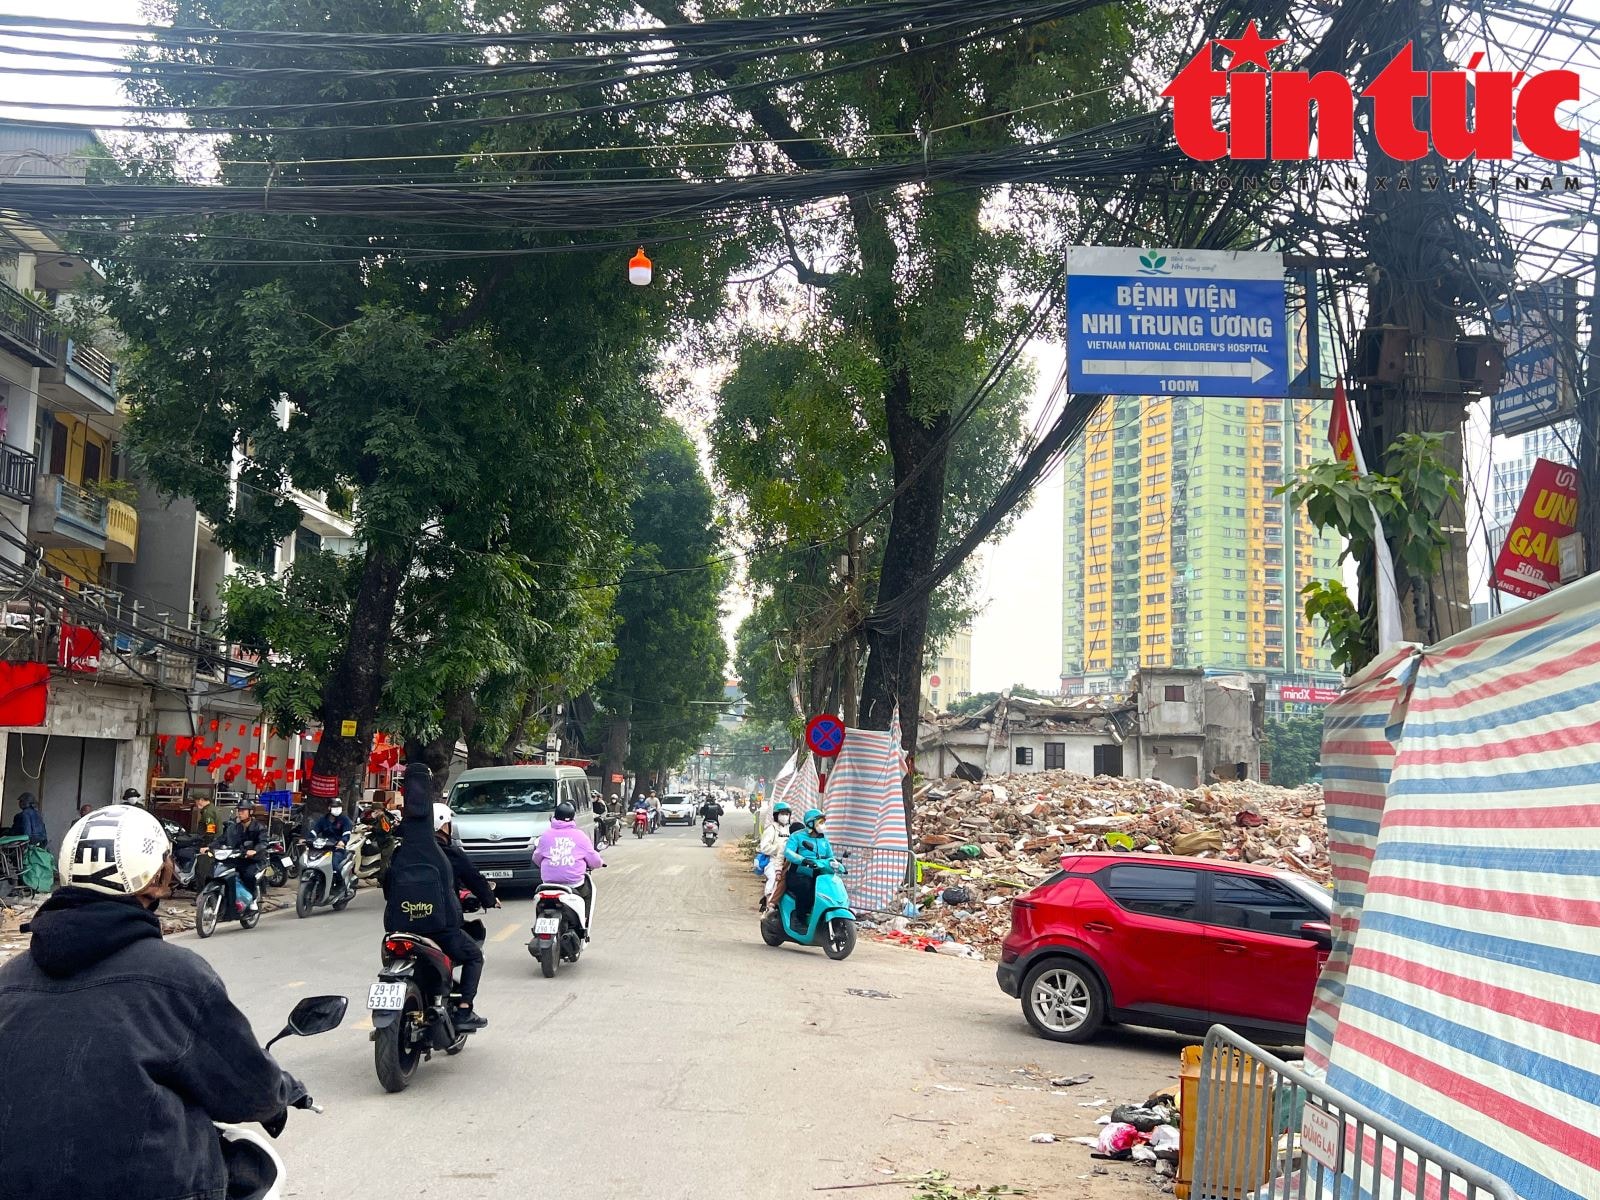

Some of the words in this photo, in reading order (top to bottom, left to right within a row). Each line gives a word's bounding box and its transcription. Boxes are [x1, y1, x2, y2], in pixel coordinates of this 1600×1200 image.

[1117, 282, 1178, 311] BỆNH
[1184, 284, 1236, 313] VIỆN
[1082, 313, 1121, 334] NHI
[1128, 315, 1204, 336] TRUNG
[1210, 314, 1273, 338] ƯƠNG
[1087, 340, 1127, 350] VIETNAM
[1128, 341, 1172, 351] NATIONAL
[1174, 342, 1226, 352] CHILDREN'S
[1227, 343, 1269, 353] HOSPITAL
[1159, 379, 1199, 392] 100M
[1516, 561, 1545, 580] 50m
[1283, 688, 1311, 700] mindX
[401, 900, 434, 916] Spring
